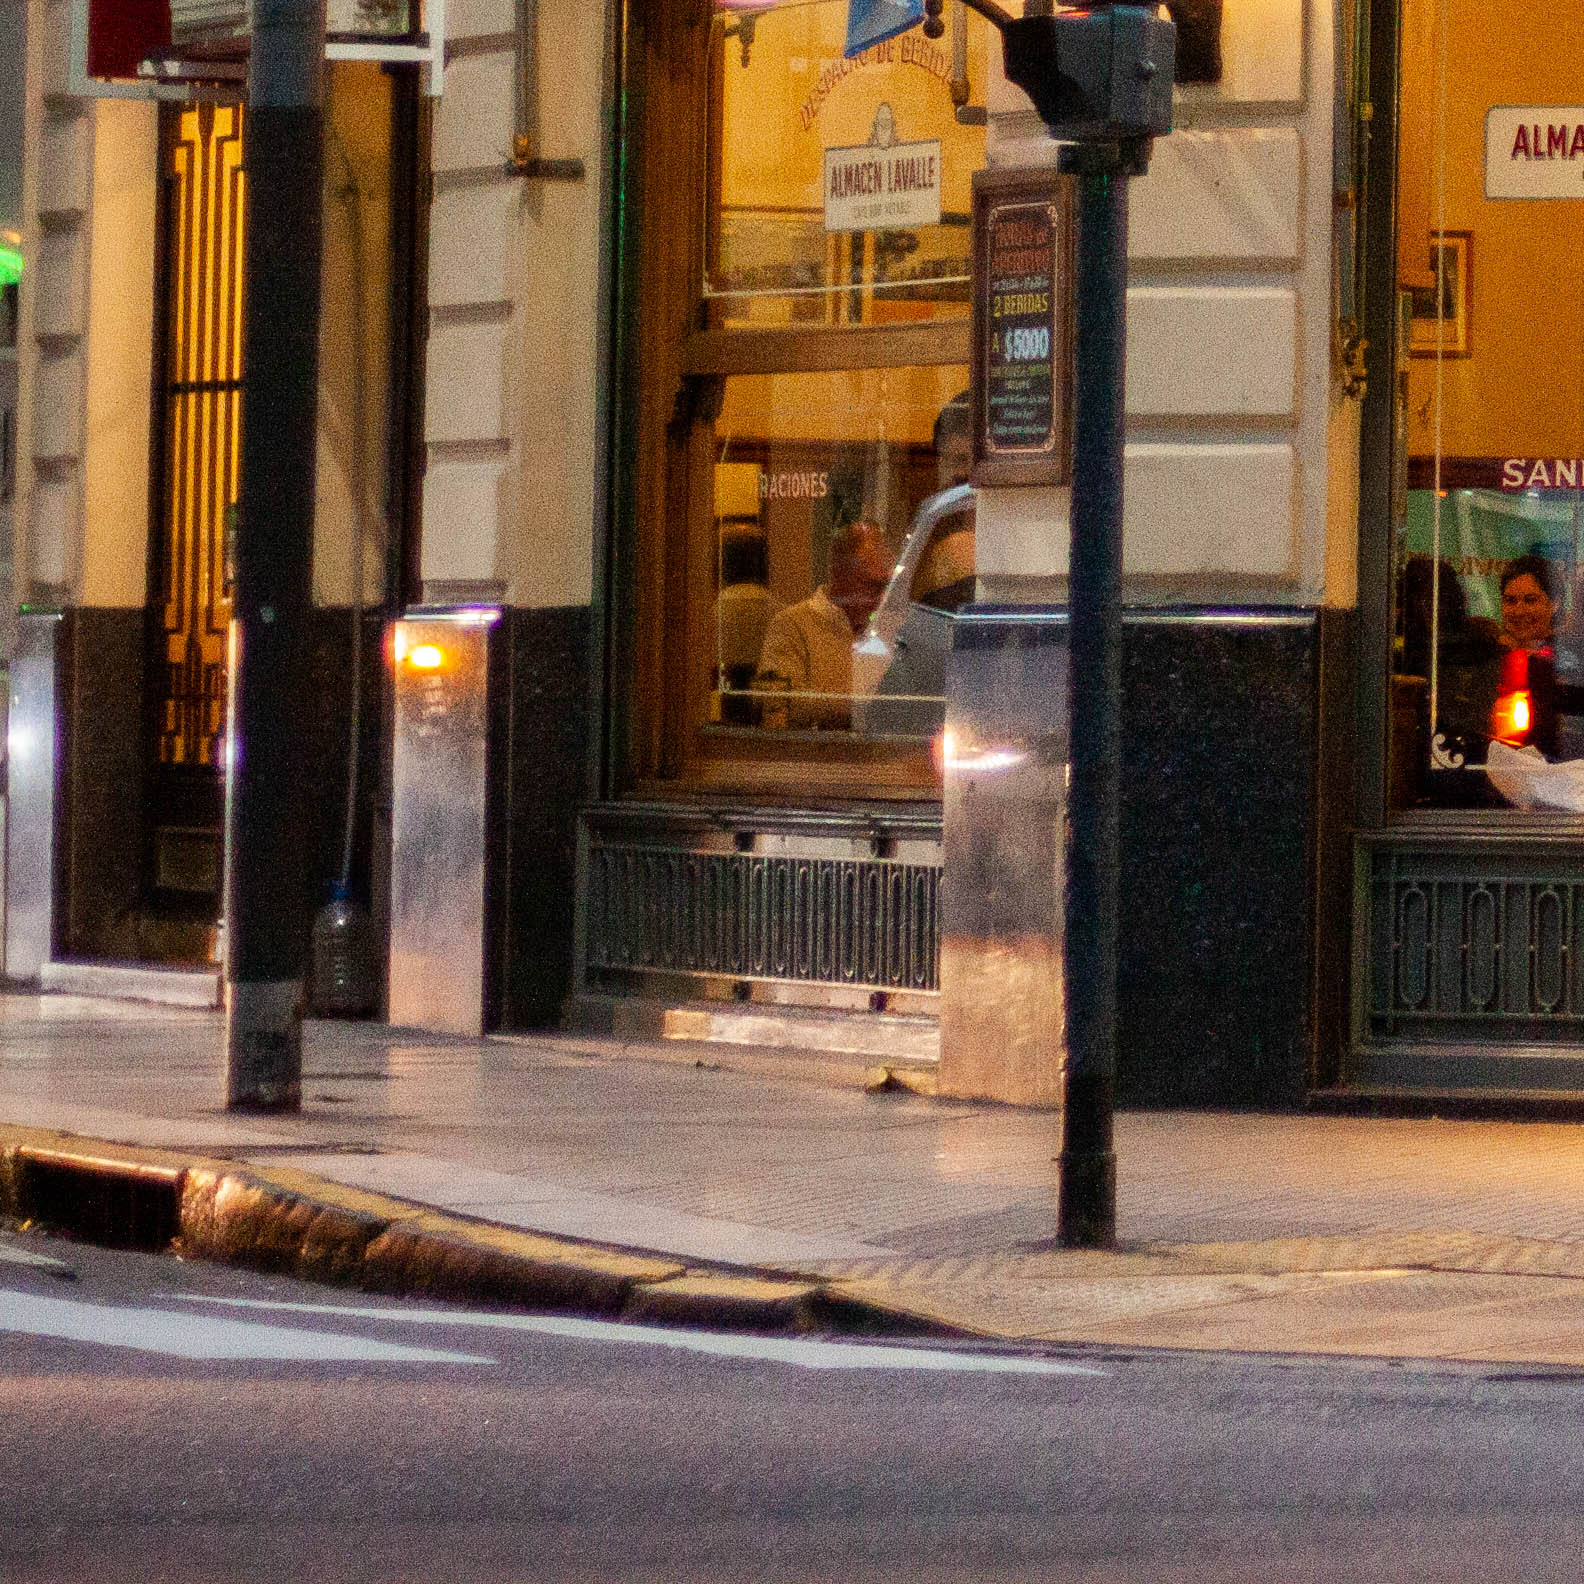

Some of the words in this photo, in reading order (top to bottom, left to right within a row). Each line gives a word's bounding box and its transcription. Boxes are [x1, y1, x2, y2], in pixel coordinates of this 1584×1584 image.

[900, 34, 955, 88] BEBIDA
[887, 155, 935, 194] LAVALLE
[992, 294, 1003, 318] 2
[1003, 292, 1050, 316] BEBIDAS
[757, 470, 829, 498] RACIONES
